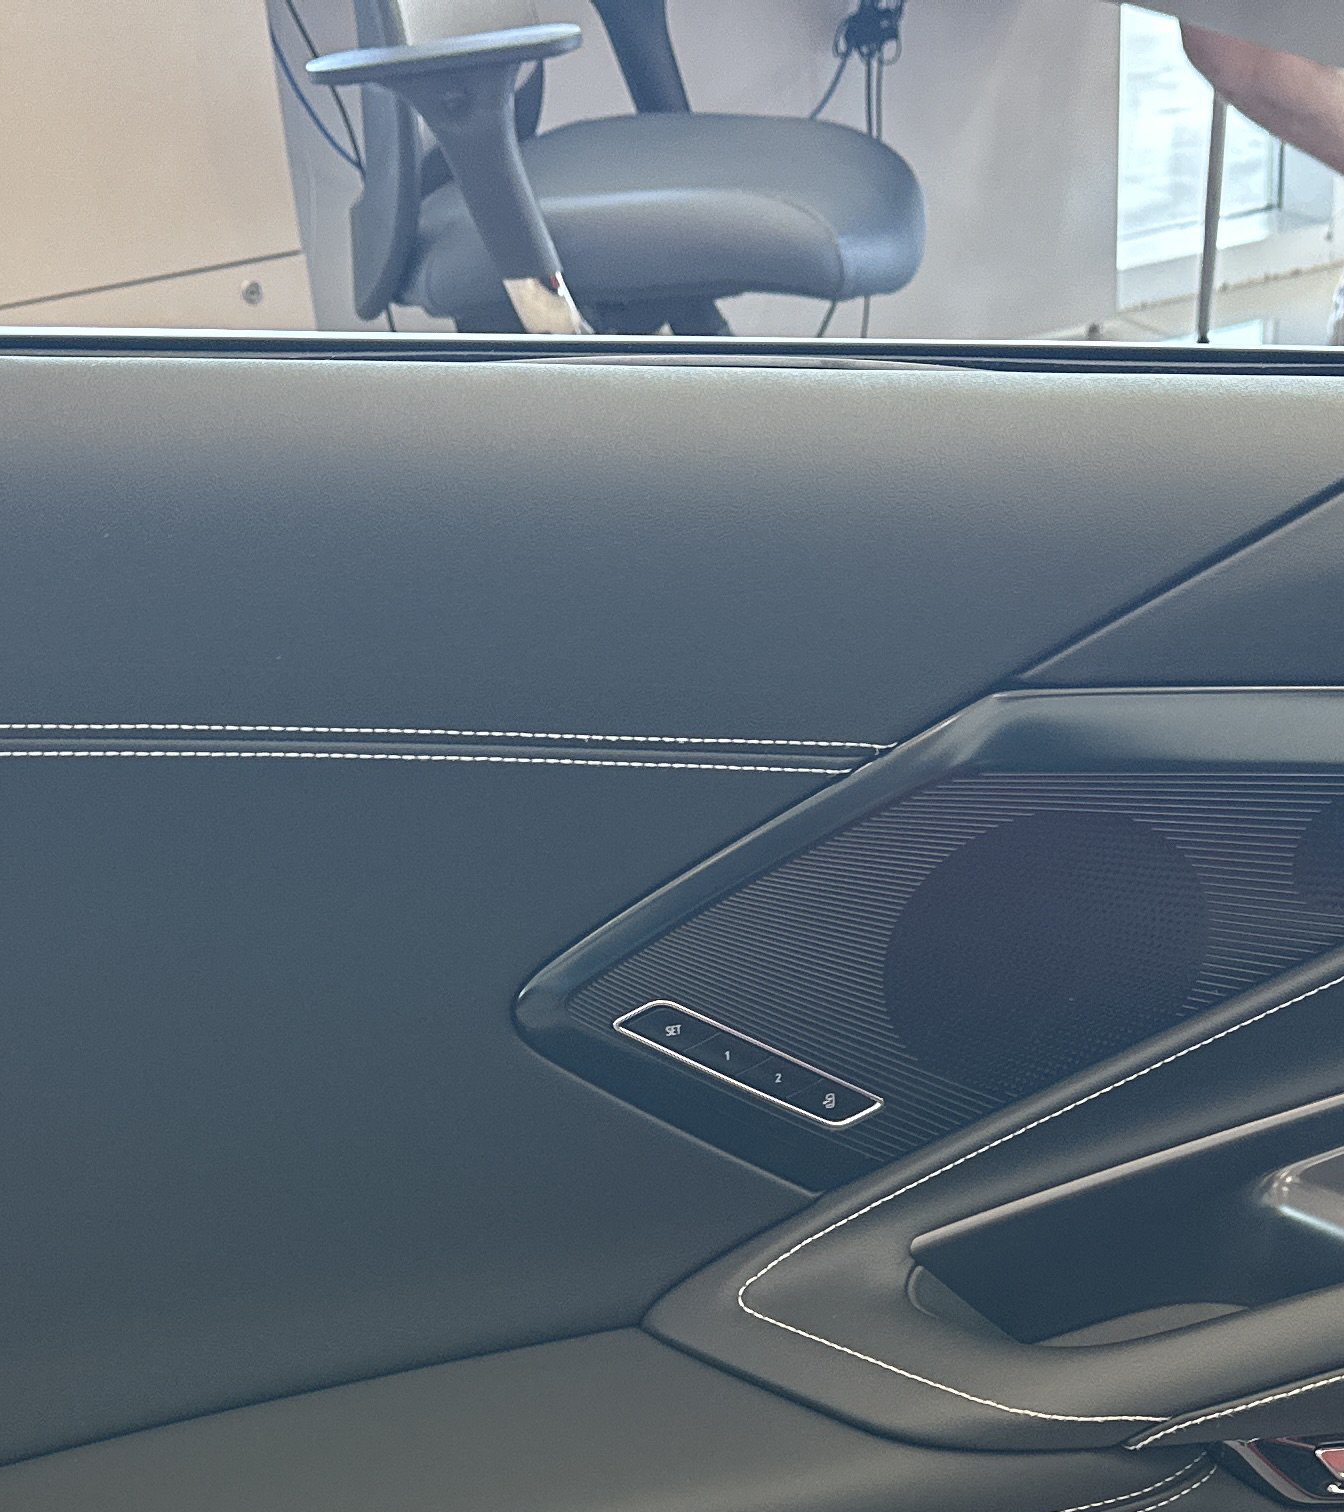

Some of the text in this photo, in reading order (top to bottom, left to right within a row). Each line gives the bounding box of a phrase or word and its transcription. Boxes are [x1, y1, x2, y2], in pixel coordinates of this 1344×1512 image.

[665, 1024, 681, 1036] SET
[724, 1050, 731, 1061] 1
[775, 1073, 782, 1084] 2
